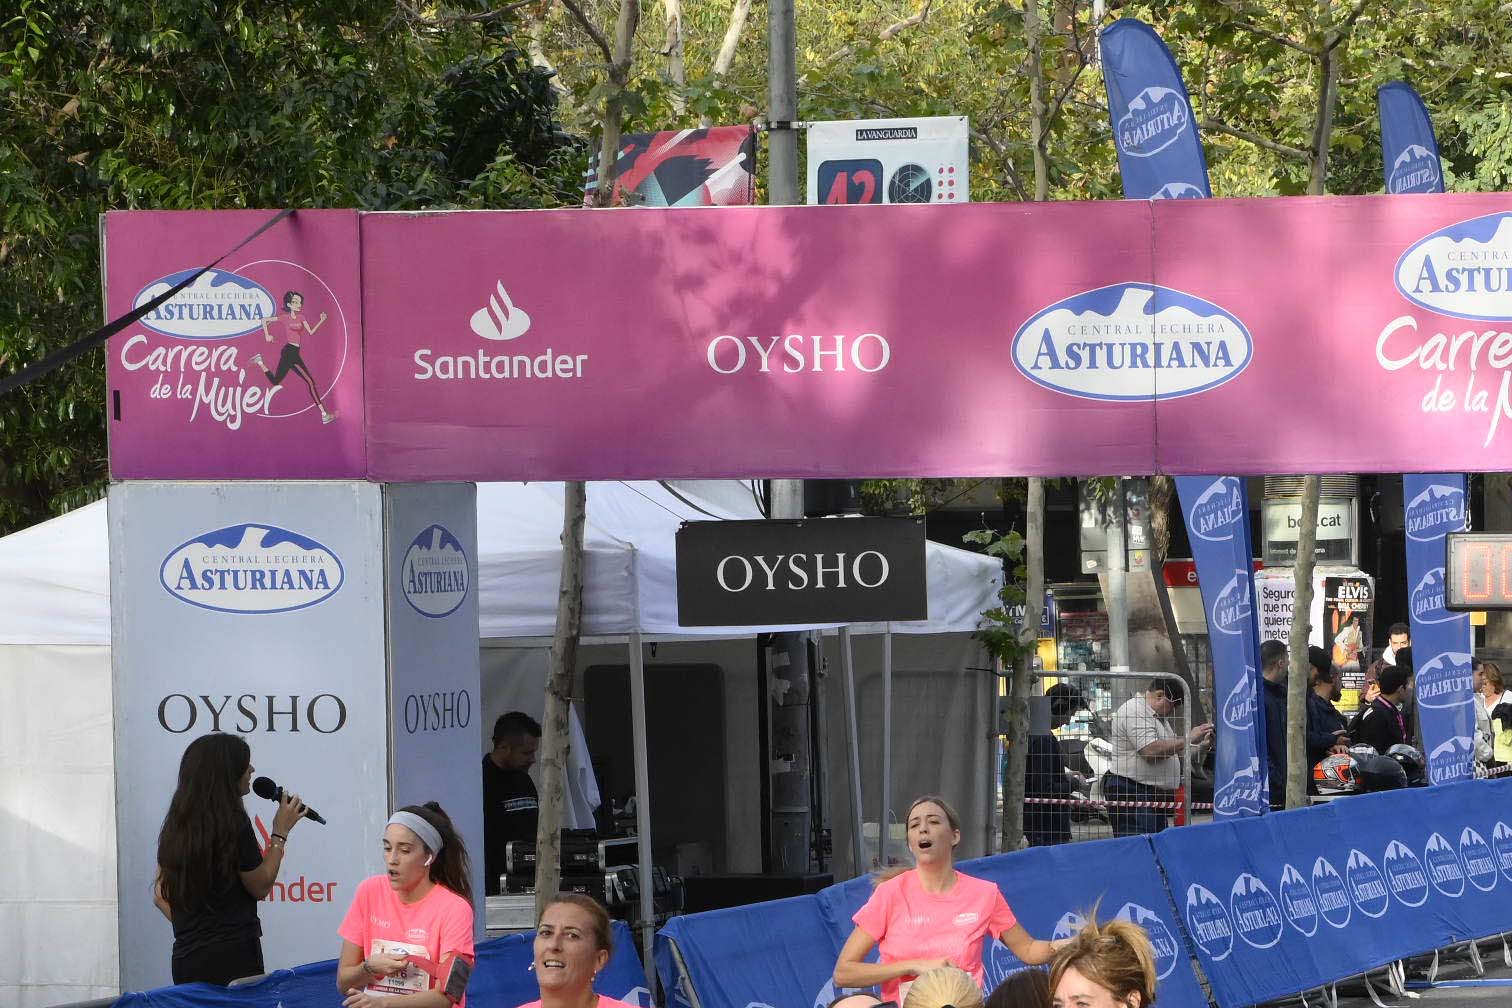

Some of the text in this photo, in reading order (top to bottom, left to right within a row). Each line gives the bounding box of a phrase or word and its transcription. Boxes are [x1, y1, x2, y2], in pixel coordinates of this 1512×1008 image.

[1067, 322, 1225, 336] CENTRAL LECHERA
[121, 334, 239, 372] Carrera
[413, 348, 587, 380] Santander
[706, 333, 890, 374] OYSHO
[1031, 327, 1233, 371] ASTURIANA
[150, 368, 282, 430] de la Mujer
[1422, 374, 1459, 413] de
[1464, 371, 1488, 412] la
[174, 557, 331, 591] ASTURIANA
[202, 555, 324, 565] CENTRAL LECHERA
[406, 559, 465, 595] ASTURIANA
[717, 550, 889, 592] OYSHO
[1264, 603, 1281, 617] que
[1338, 586, 1369, 599] ELVIS
[1264, 615, 1292, 628] quiere
[157, 693, 347, 734] OYSHO
[404, 689, 471, 734] OYSHO
